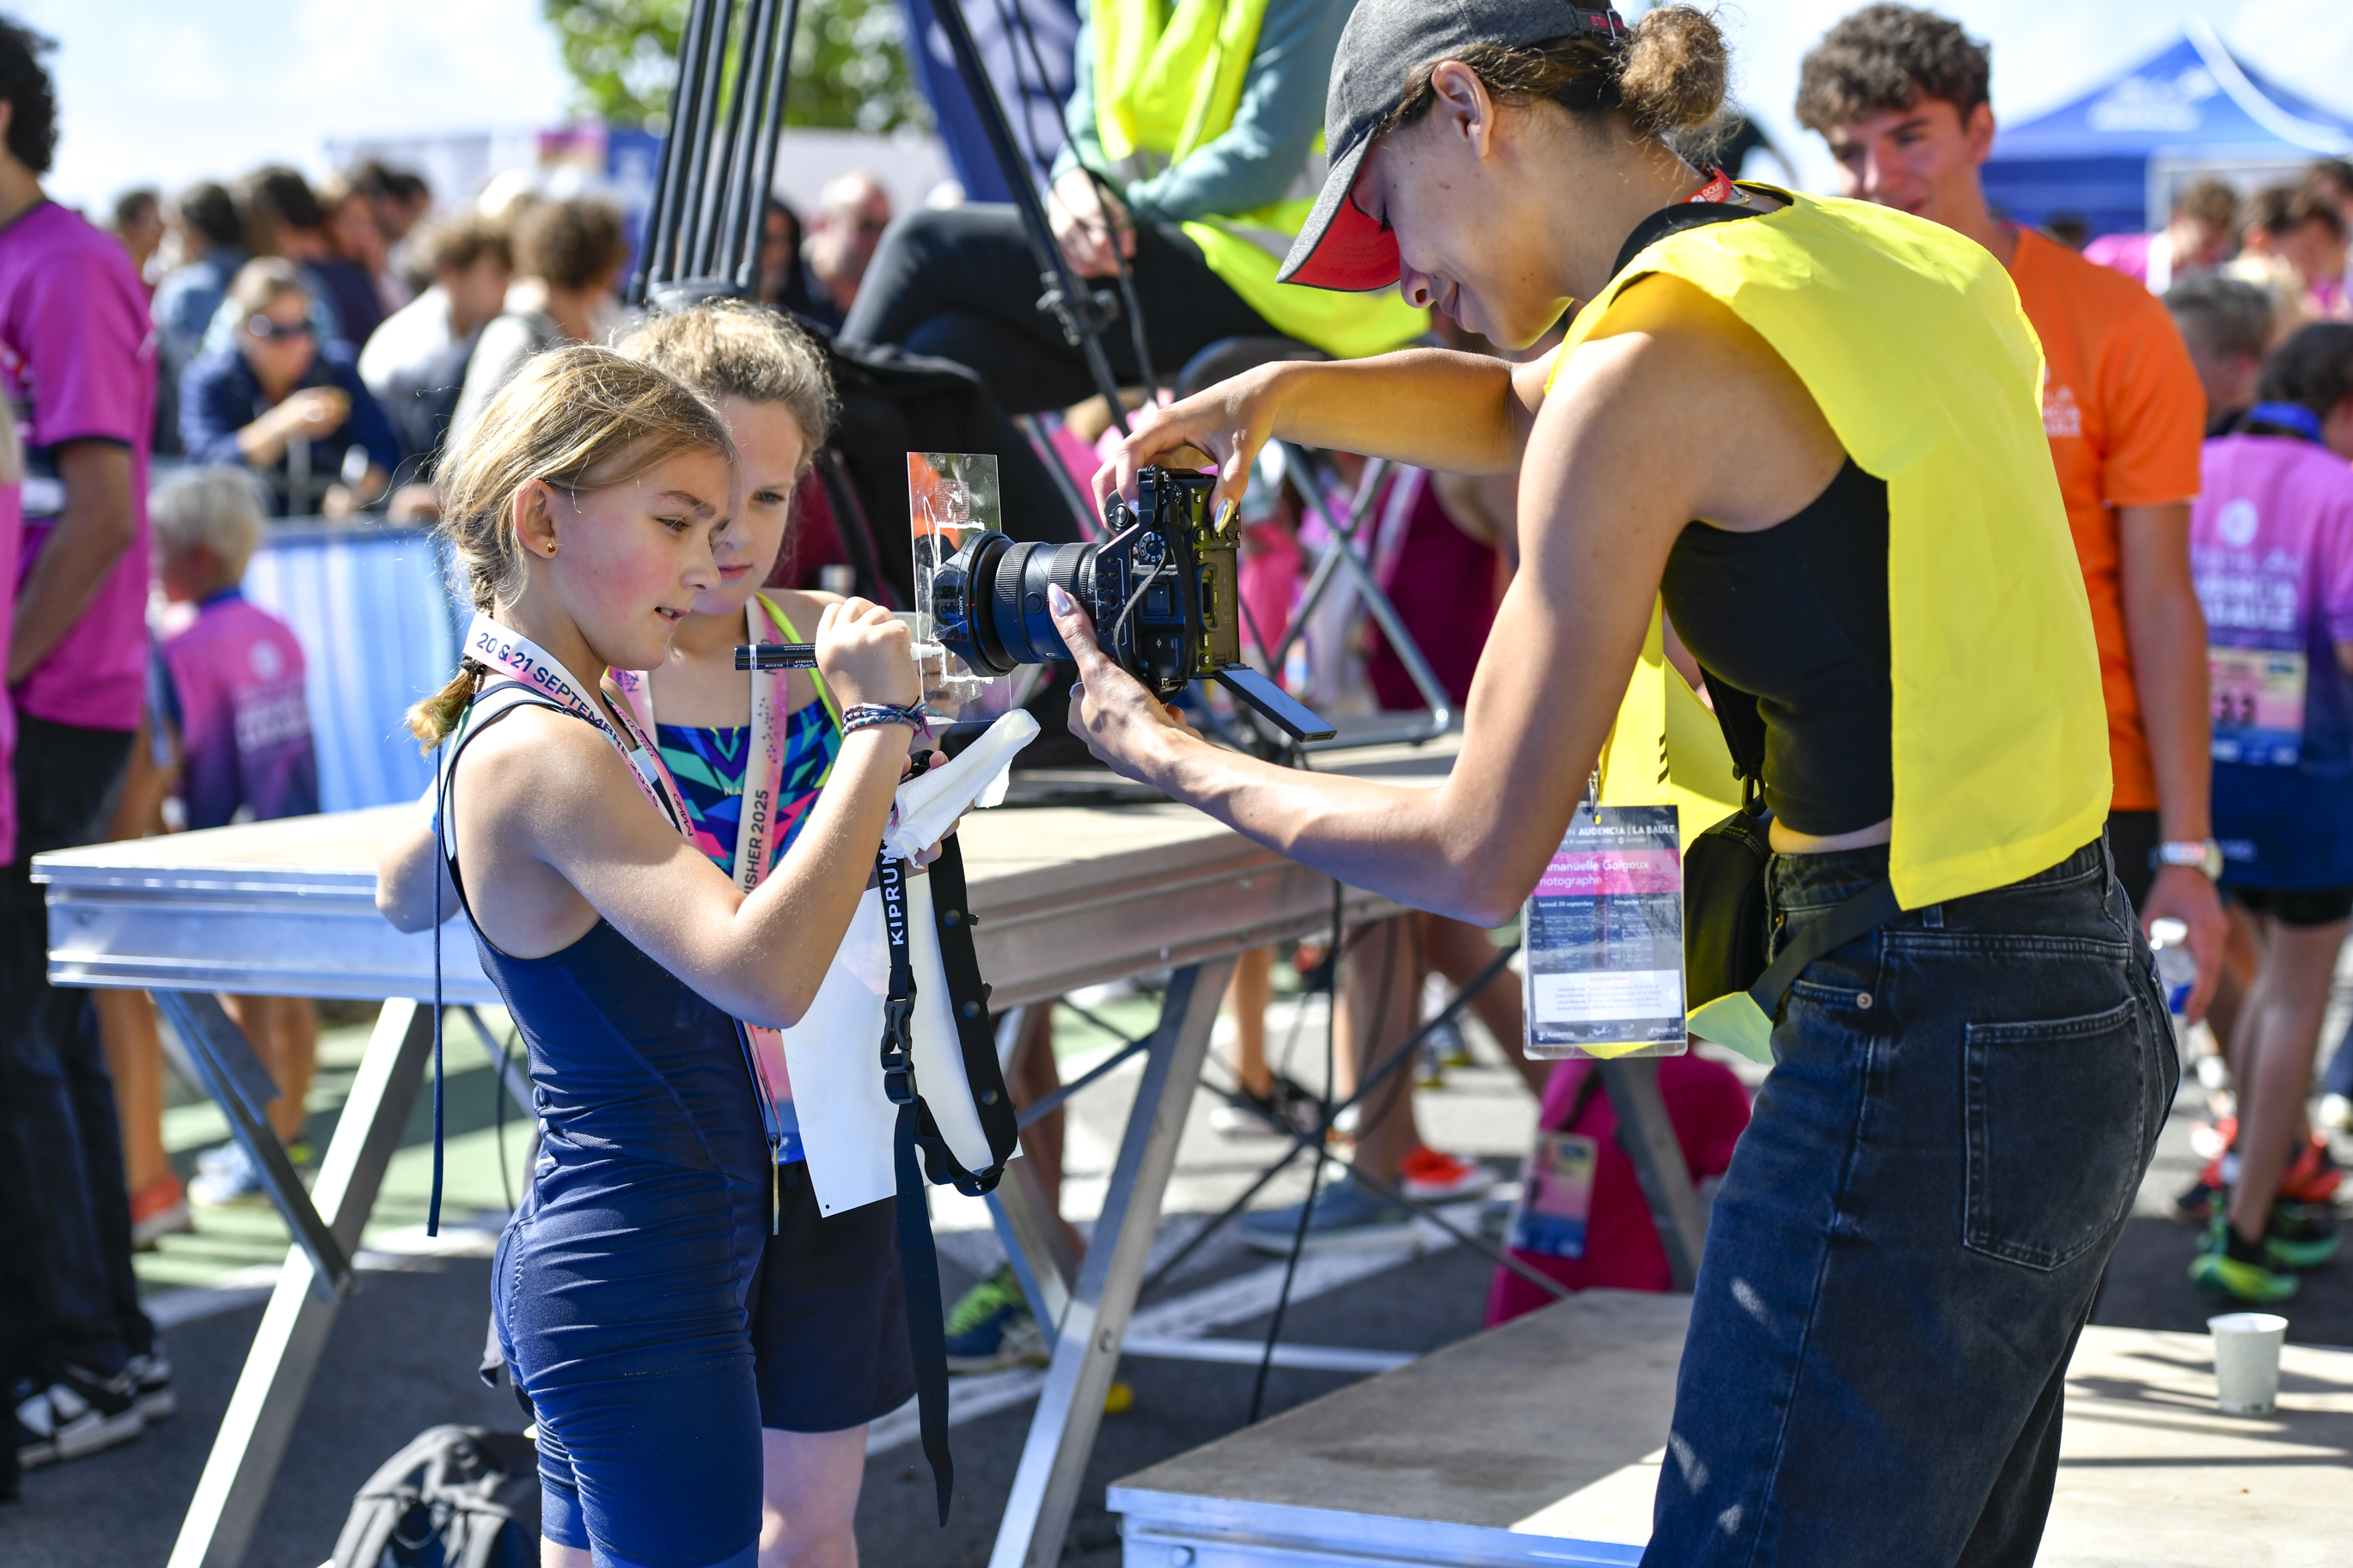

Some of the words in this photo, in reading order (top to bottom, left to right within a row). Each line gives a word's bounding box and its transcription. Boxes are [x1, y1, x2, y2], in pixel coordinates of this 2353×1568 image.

[475, 632, 498, 654] 20
[497, 644, 511, 662] &
[510, 651, 535, 673] 21
[532, 665, 629, 759] SEPTEMBRE
[629, 761, 659, 808] 2025
[749, 790, 768, 834] 2025
[1578, 826, 1625, 836] AUDENCIA
[1633, 825, 1644, 835] LA
[1647, 825, 1676, 834] BAULE
[743, 838, 762, 895] ISHER
[1540, 875, 1602, 888] hotographe
[1602, 860, 1649, 873] Goigoux
[879, 848, 905, 946] KIPRUN
